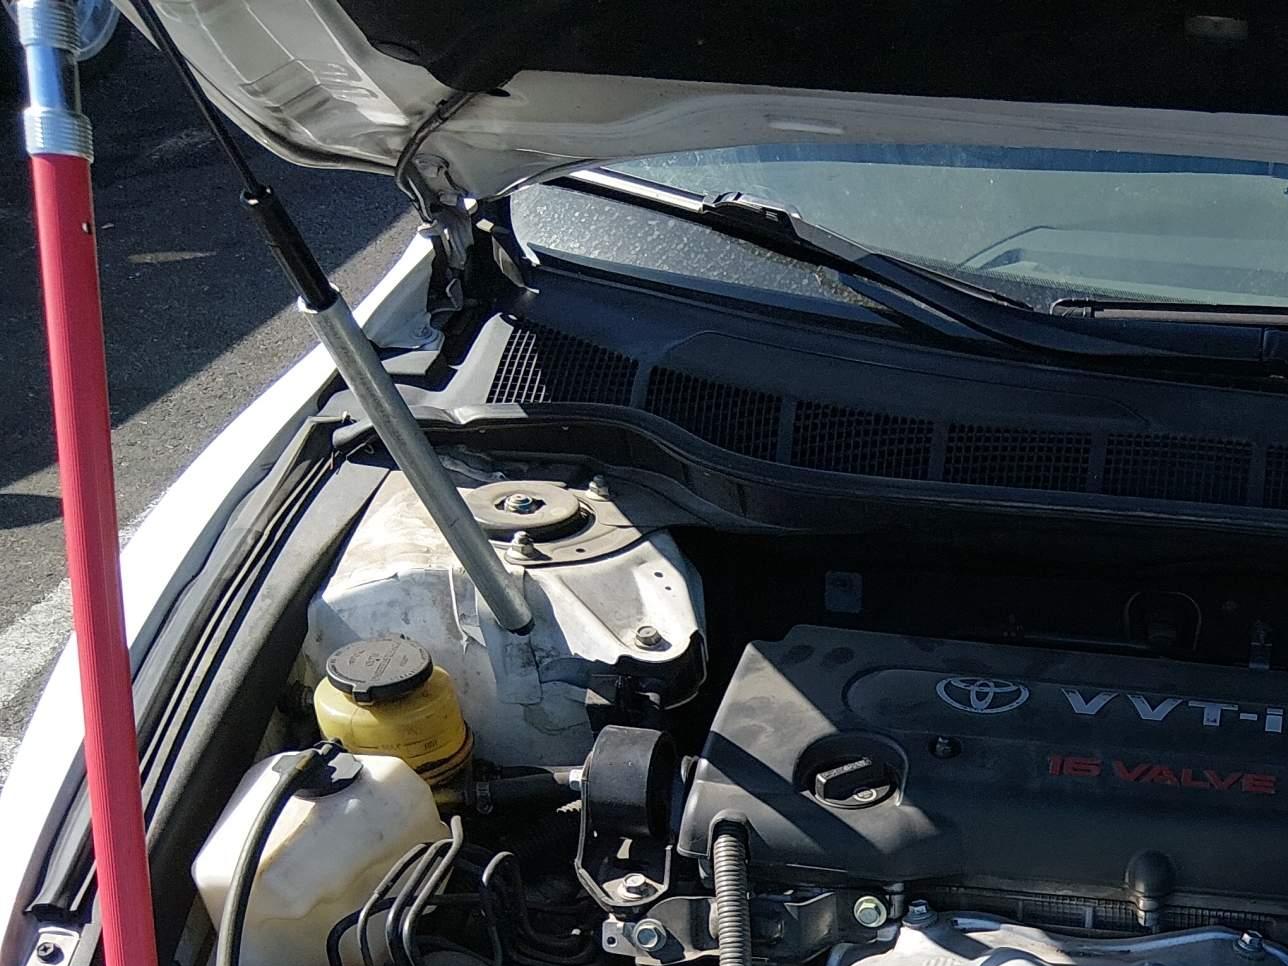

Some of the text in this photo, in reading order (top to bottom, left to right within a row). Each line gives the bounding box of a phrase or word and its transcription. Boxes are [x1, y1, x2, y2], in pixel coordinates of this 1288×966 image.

[1061, 687, 1283, 733] VVT-i
[1047, 755, 1277, 796] 16 VALVE
